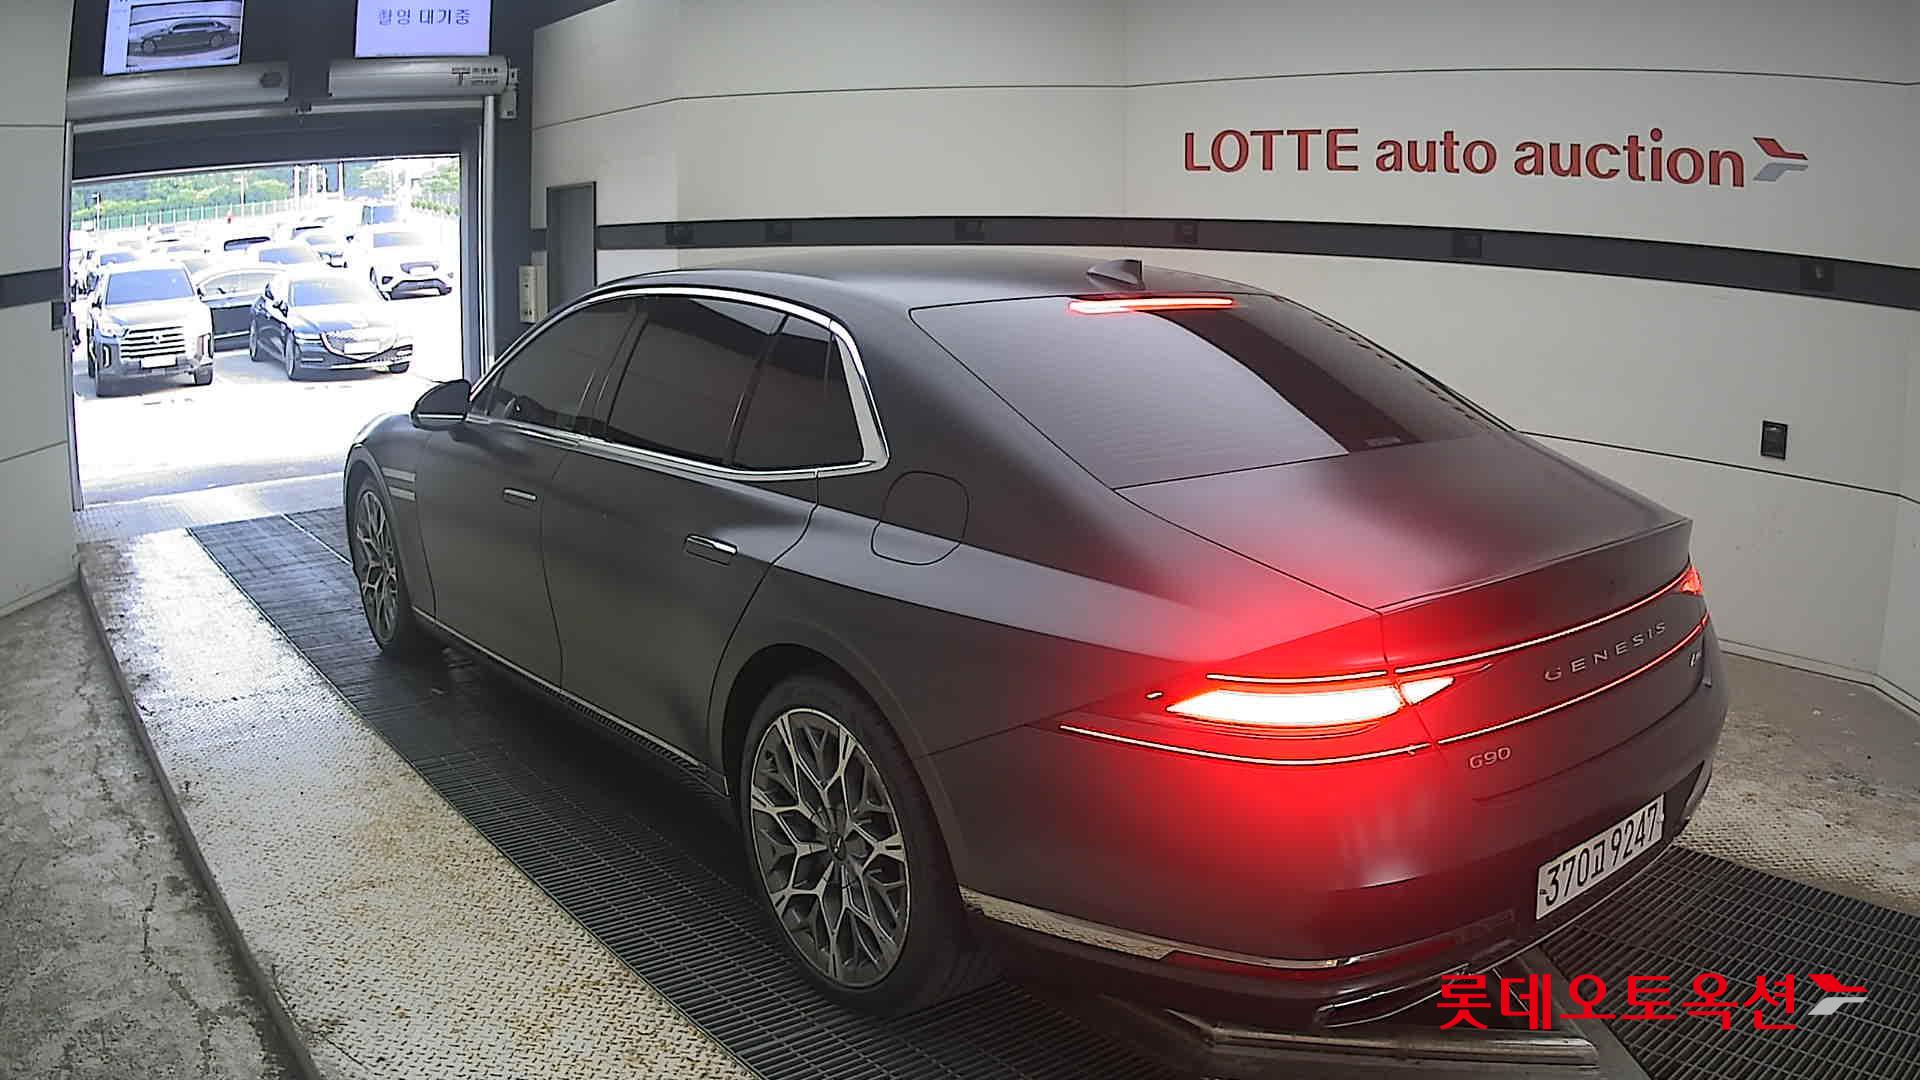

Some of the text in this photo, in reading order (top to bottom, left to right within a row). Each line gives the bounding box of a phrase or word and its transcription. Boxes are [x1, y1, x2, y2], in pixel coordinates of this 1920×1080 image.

[419, 8, 471, 26] 대기중
[1184, 128, 1745, 188] LOTTE auto auction
[1544, 622, 1667, 682] GENESIS
[1469, 746, 1513, 770] G90
[1545, 802, 1659, 906] 370고 9247
